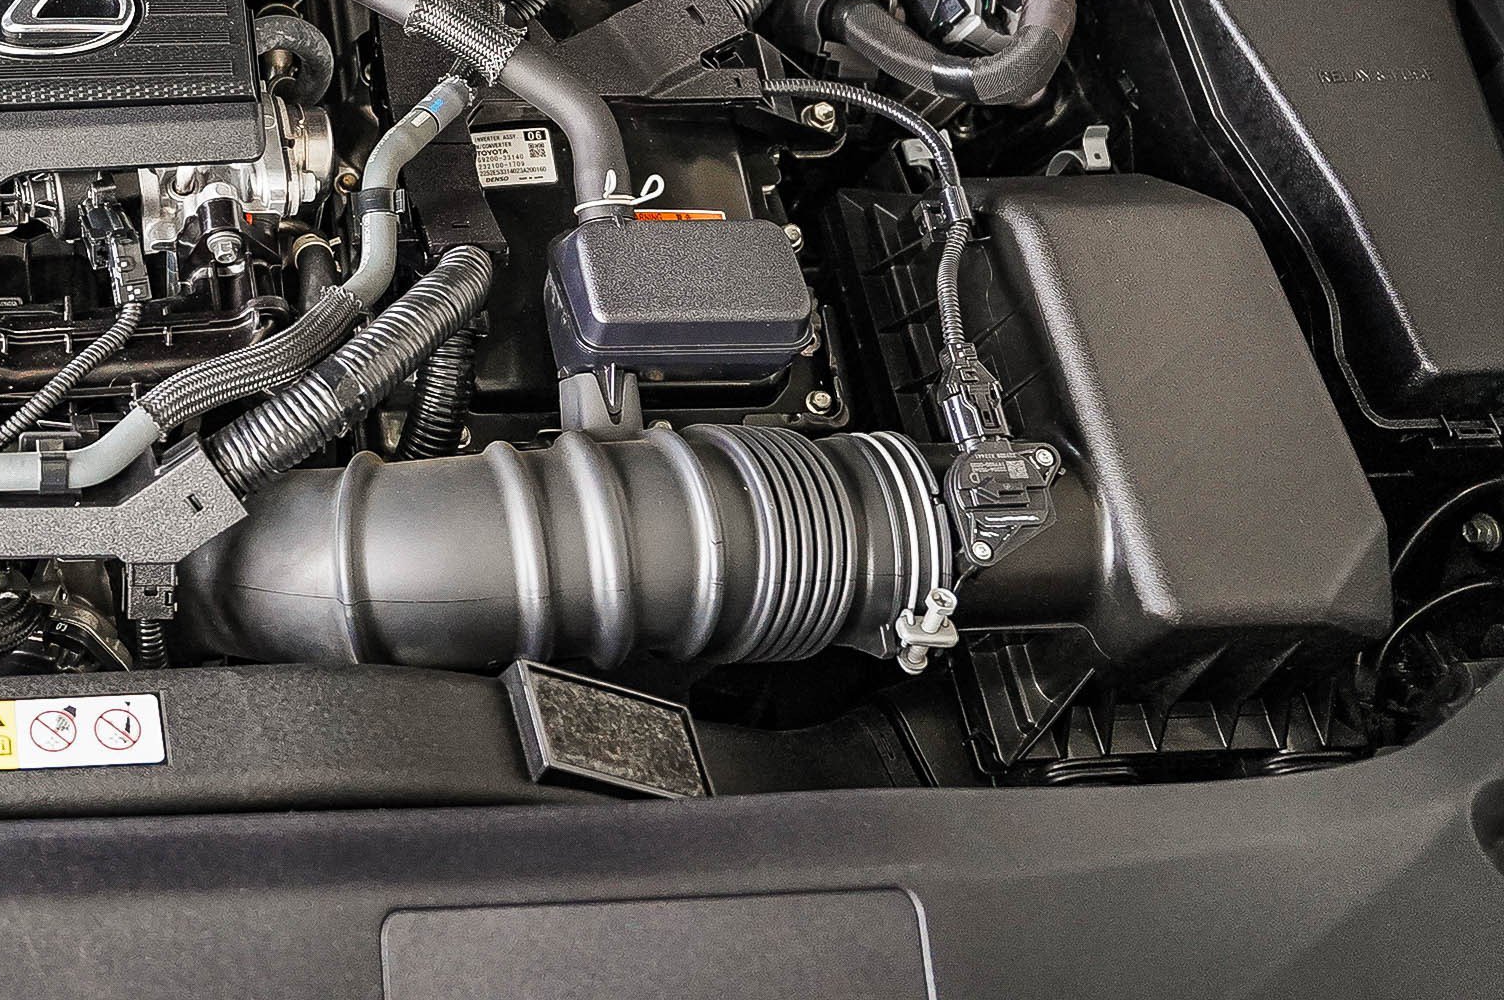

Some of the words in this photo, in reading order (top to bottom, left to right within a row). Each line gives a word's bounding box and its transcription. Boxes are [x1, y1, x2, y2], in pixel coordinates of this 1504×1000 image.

[1317, 68, 1371, 82] RELAY
[527, 131, 542, 140] 06
[476, 148, 509, 156] TOYOTA
